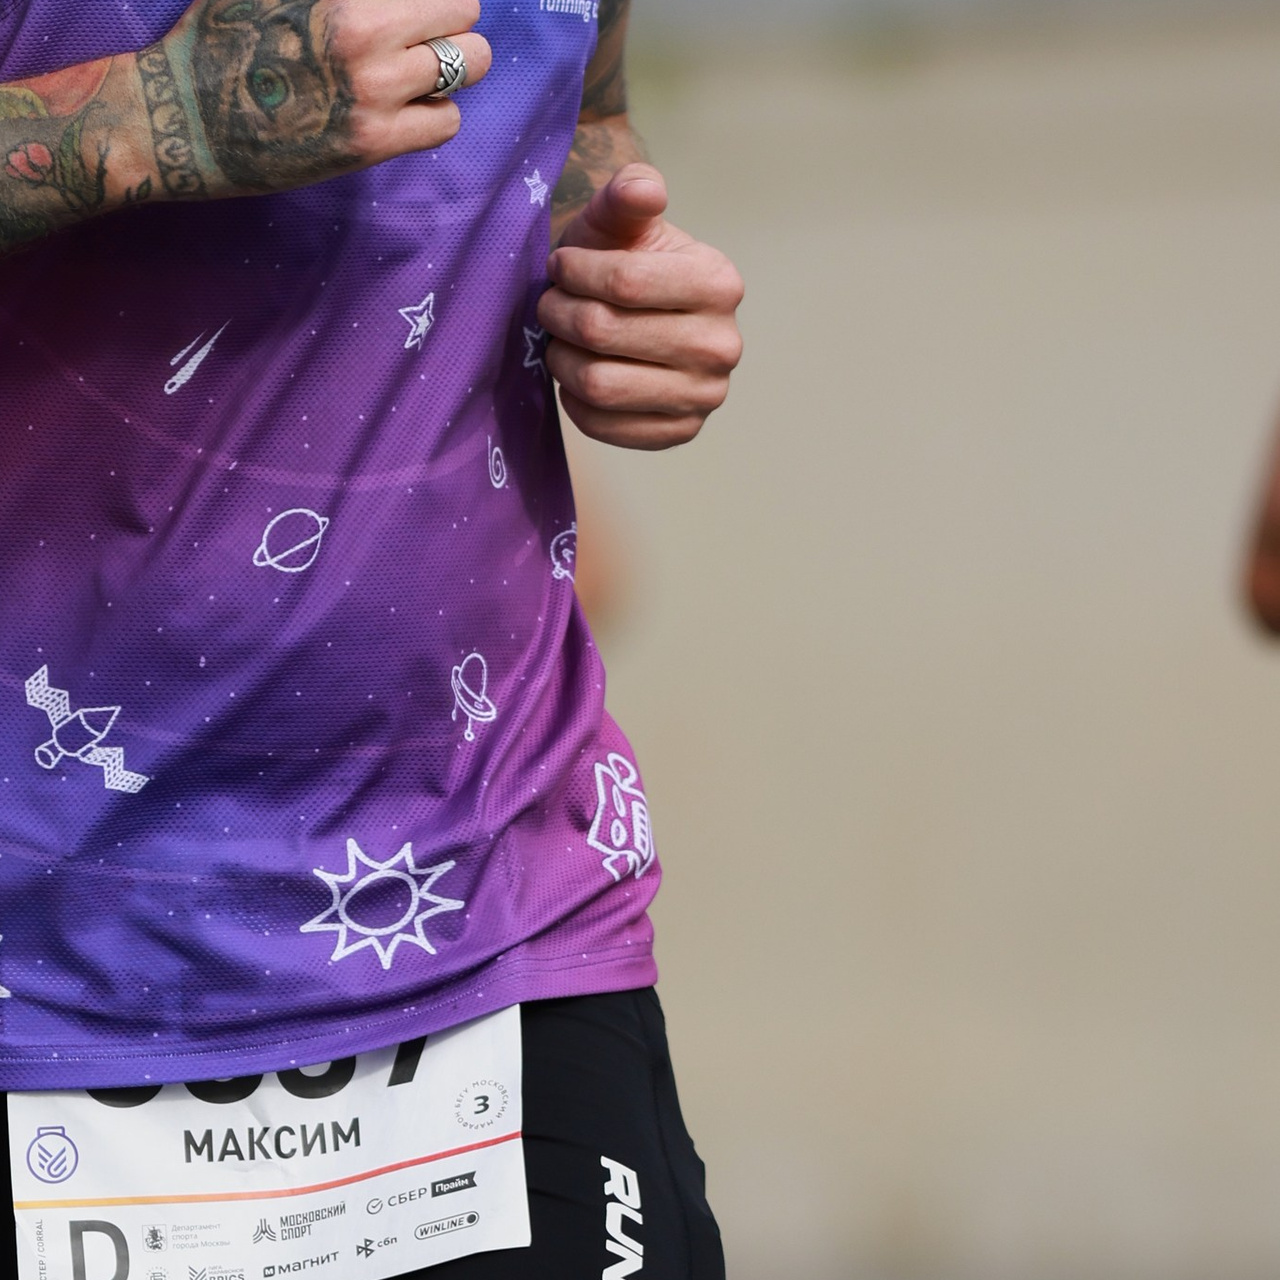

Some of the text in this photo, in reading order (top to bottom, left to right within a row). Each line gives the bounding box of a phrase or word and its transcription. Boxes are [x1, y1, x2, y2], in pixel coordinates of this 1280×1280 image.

[474, 1095, 489, 1114] 3
[183, 1117, 361, 1163] МАКСИМ
[387, 1177, 469, 1207] СБЕР Прайм
[280, 1201, 346, 1228] МОСКОВСКИЙ
[36, 1219, 45, 1252] CORRAL
[171, 1223, 221, 1232] Департамент
[281, 1223, 313, 1241] СПОРТ
[419, 1217, 465, 1237] WINLINE
[171, 1233, 198, 1241] спорта
[377, 1236, 398, 1248] сбп
